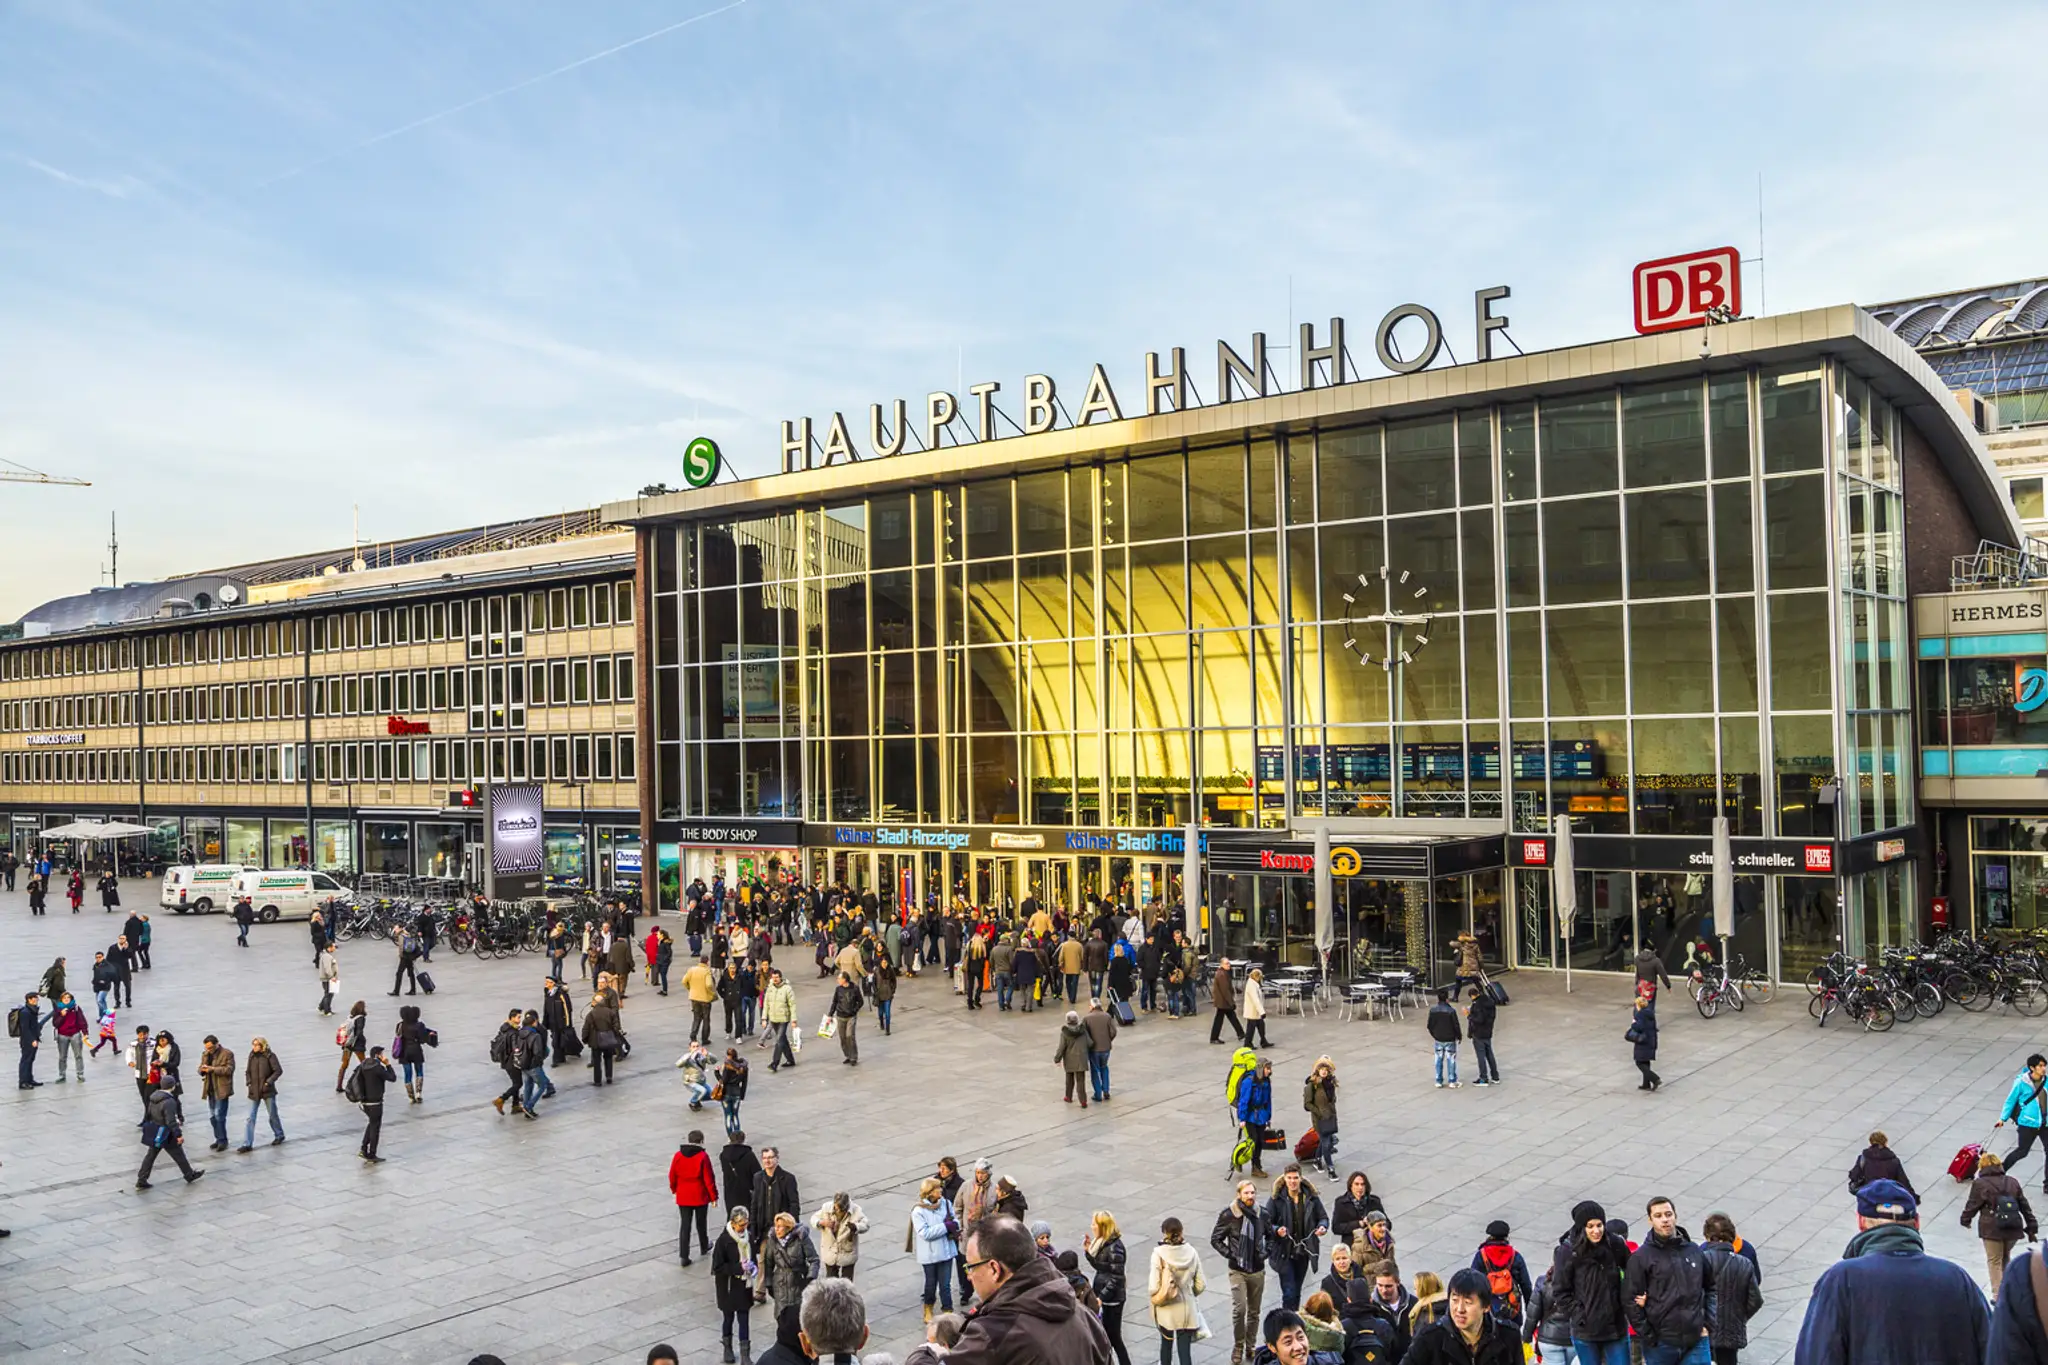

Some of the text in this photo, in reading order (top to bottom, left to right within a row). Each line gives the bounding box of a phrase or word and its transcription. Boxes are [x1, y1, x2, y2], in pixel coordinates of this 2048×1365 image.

[1646, 261, 1725, 321] DB
[781, 286, 1511, 474] HAUPTBAHNHOF
[689, 443, 709, 480] S
[26, 733, 84, 745] STARBUCKS COFFEE
[681, 828, 758, 842] THE BODY SHOP
[835, 827, 970, 850] Kölner Stadt-Anzeiger
[1065, 832, 1113, 849] Kölner
[1261, 850, 1316, 873] Kamp
[1738, 852, 1796, 867] schneller.
[1806, 849, 1831, 864] EXPRESS
